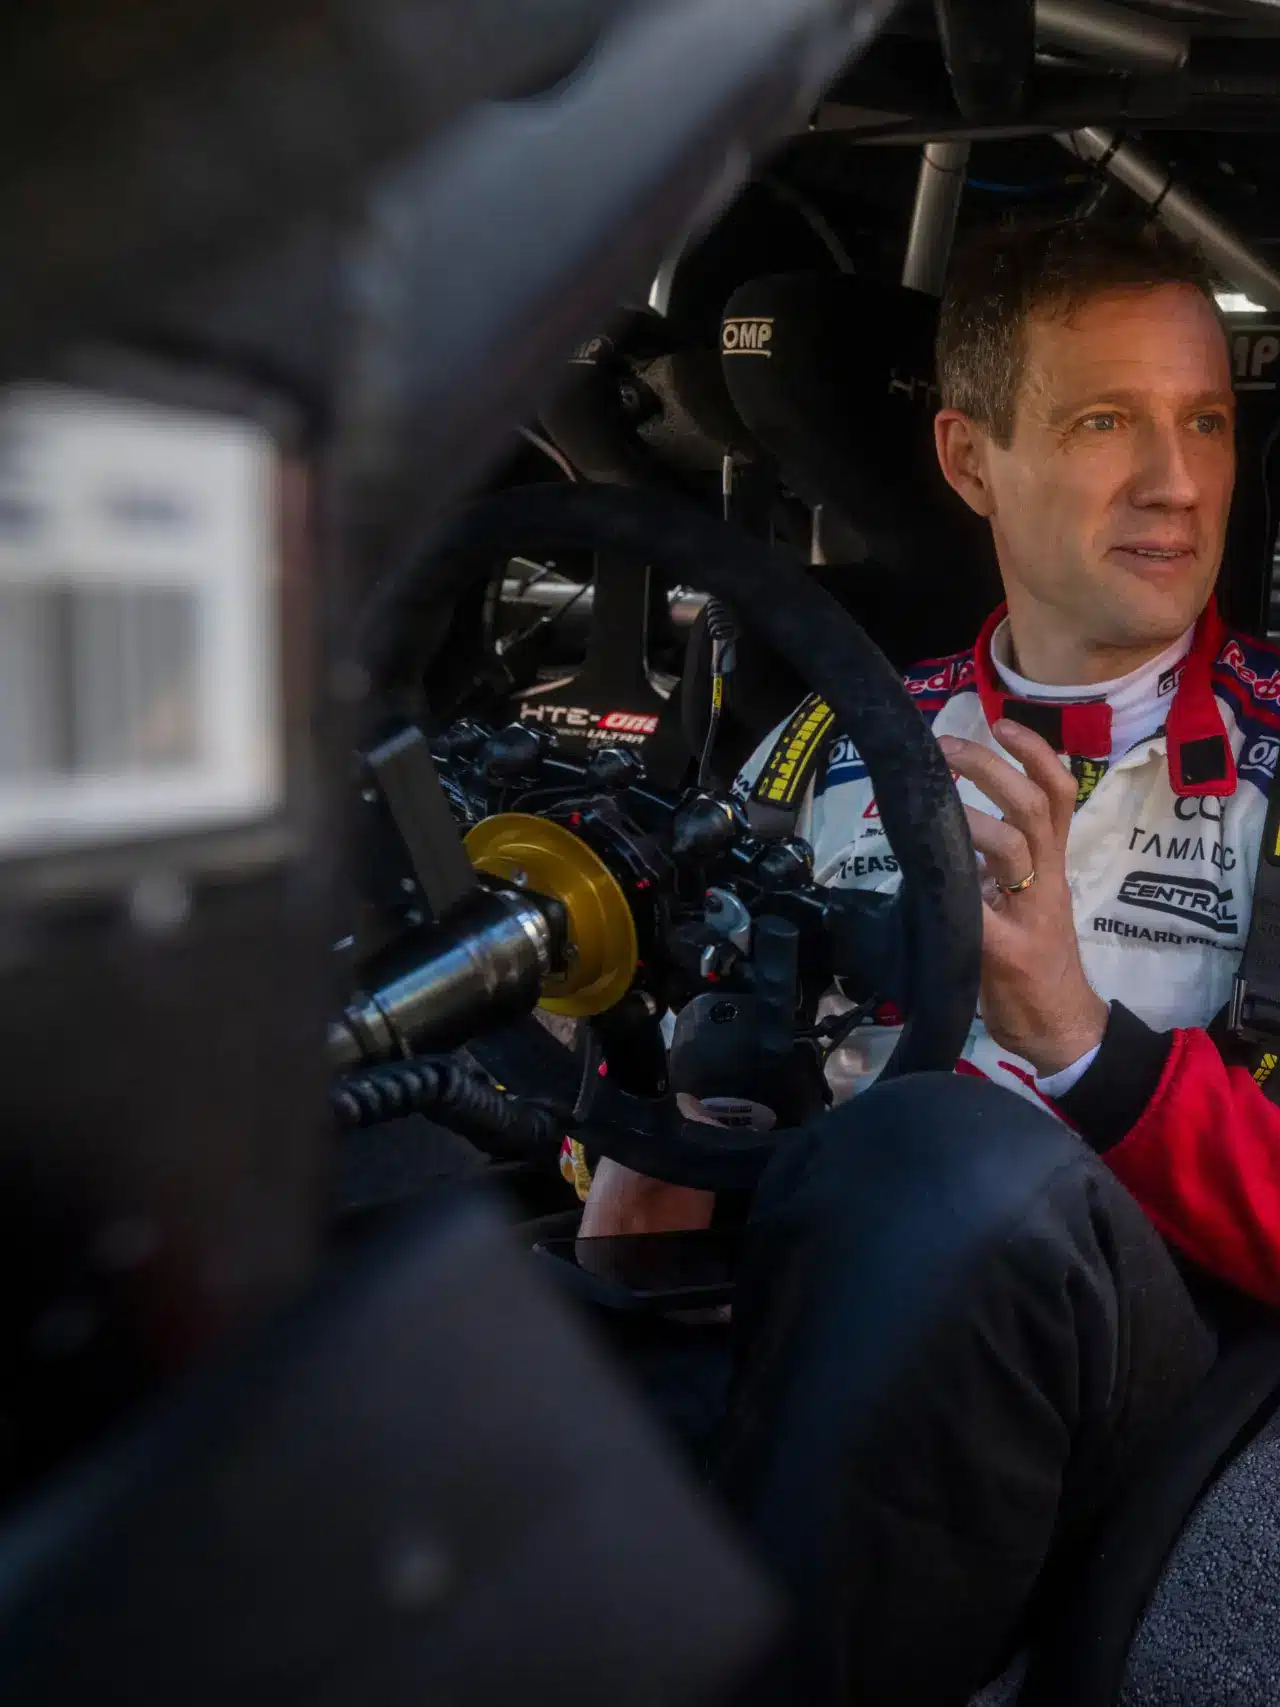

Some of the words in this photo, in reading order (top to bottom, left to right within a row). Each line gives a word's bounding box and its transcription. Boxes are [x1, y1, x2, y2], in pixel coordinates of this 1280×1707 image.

[723, 323, 773, 349] OMP
[1248, 741, 1280, 769] OM
[1093, 916, 1183, 945] RICHARD
